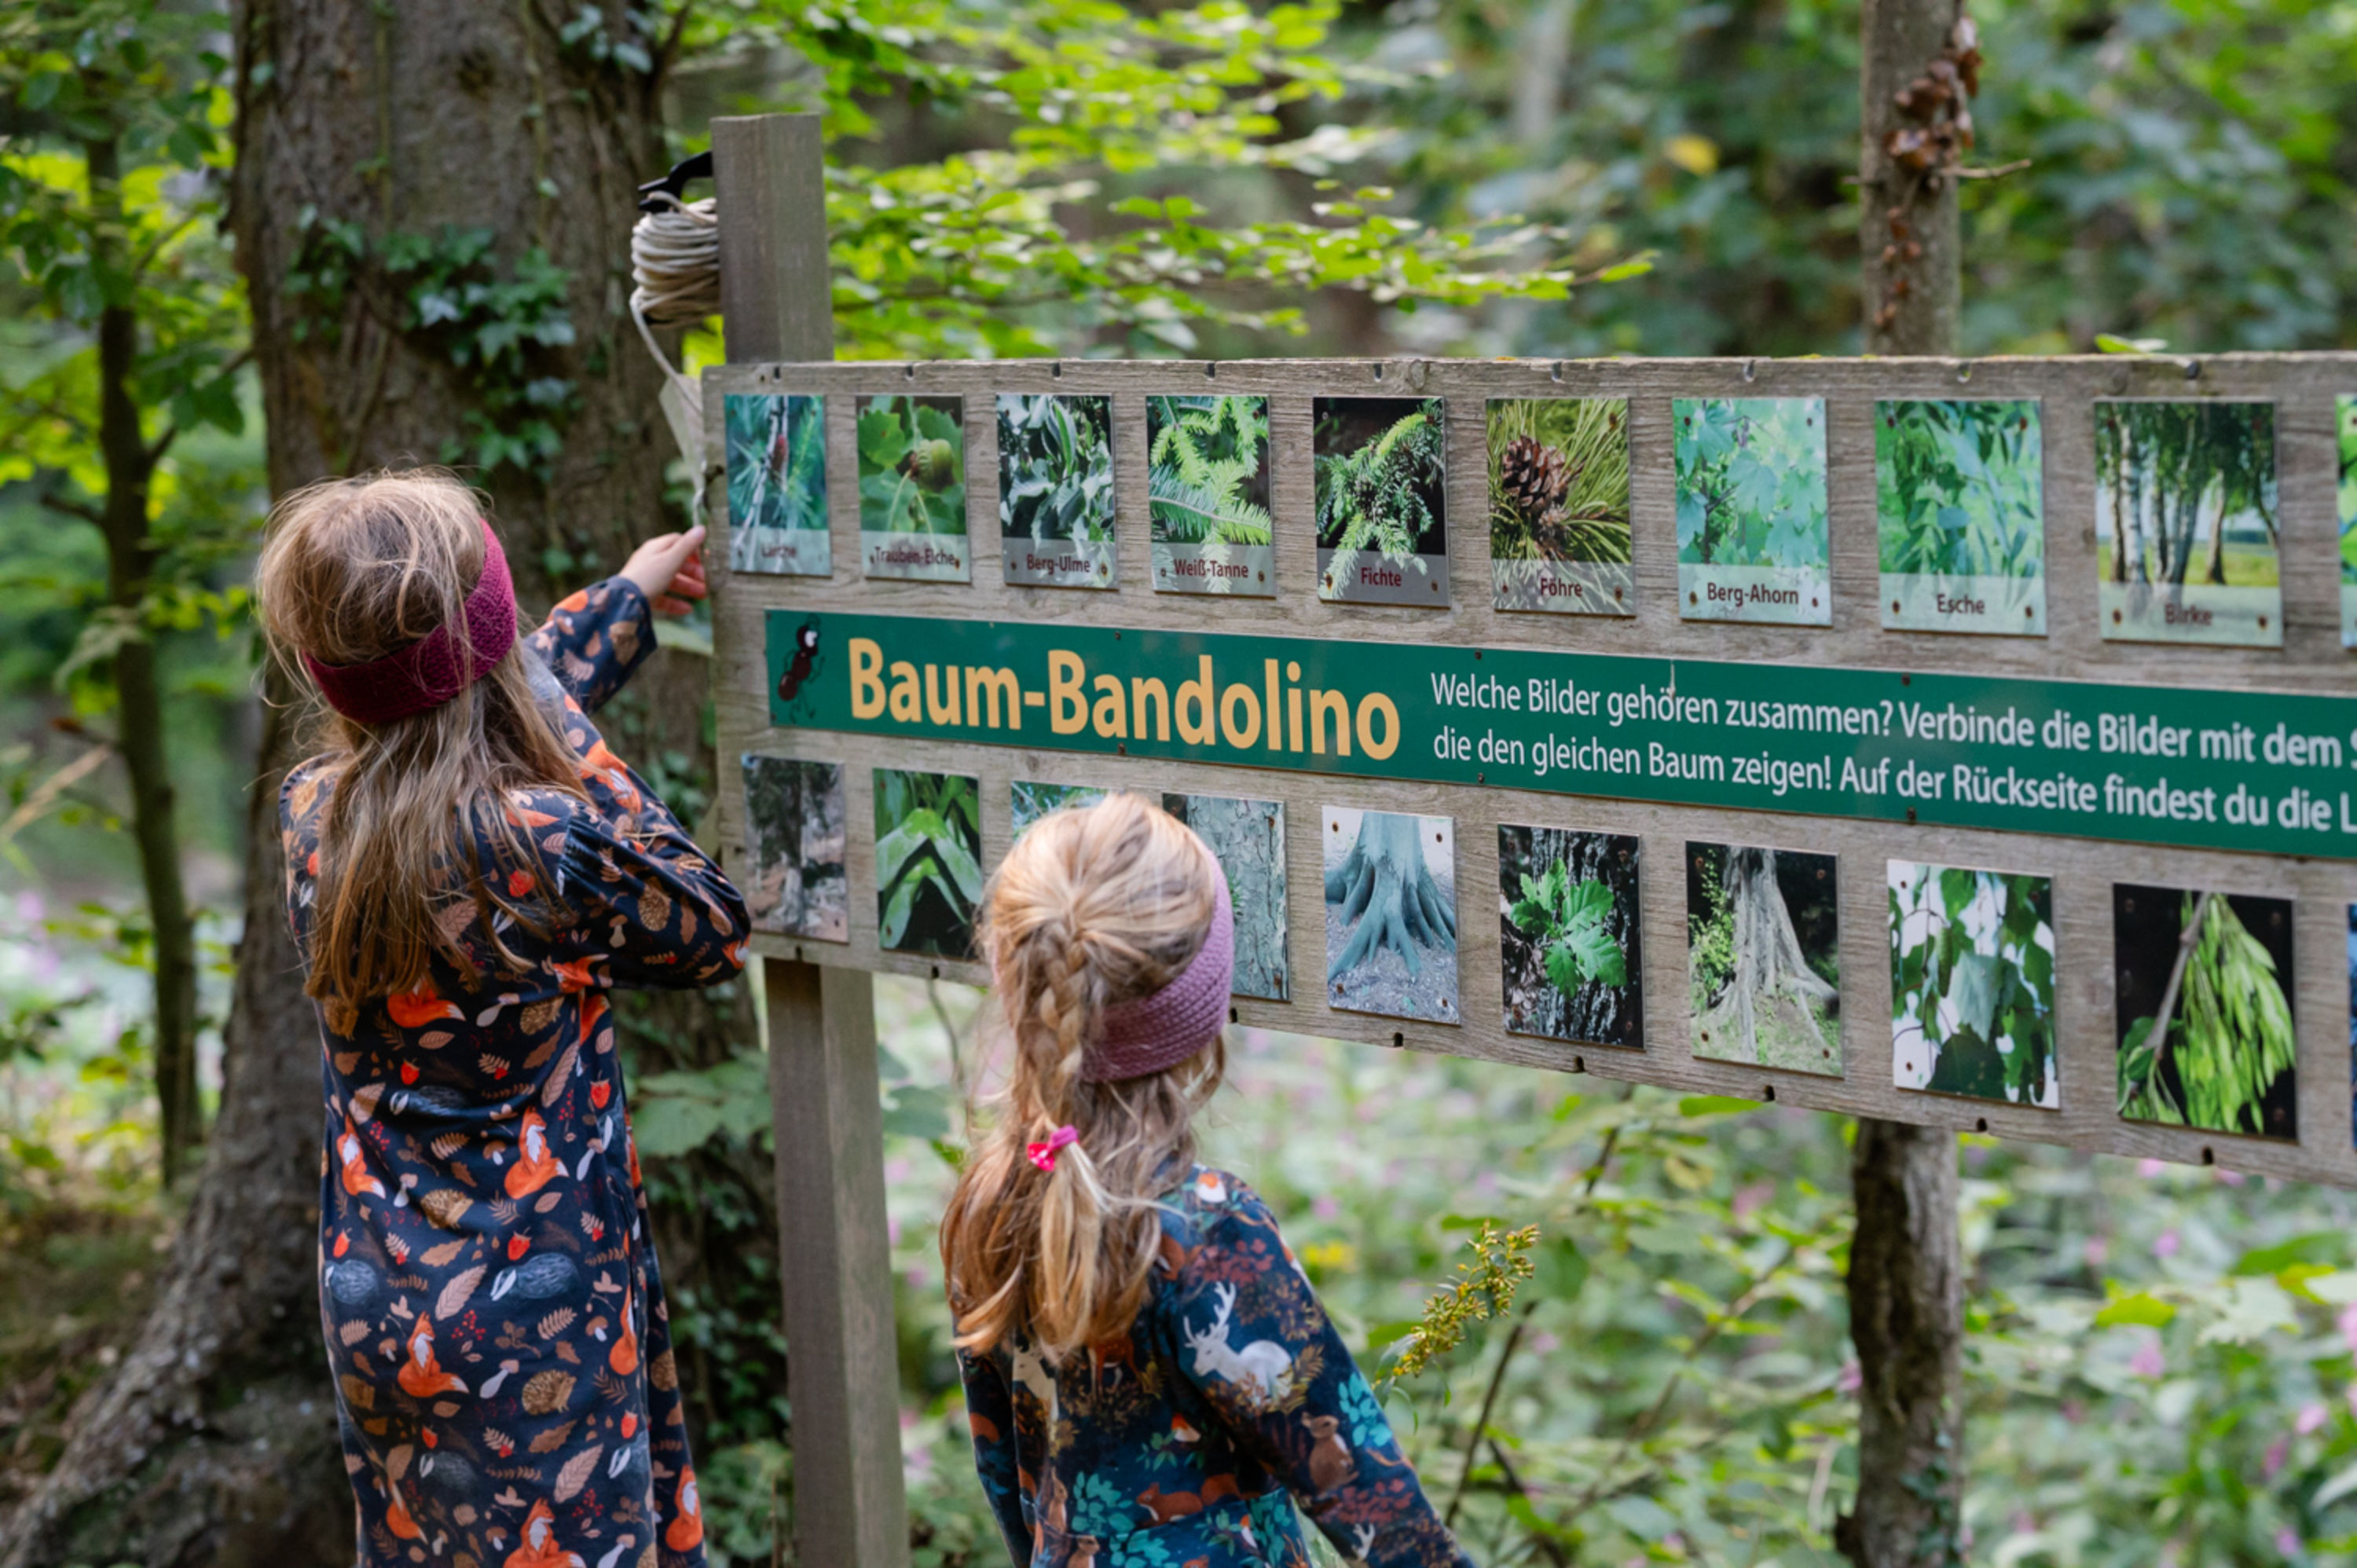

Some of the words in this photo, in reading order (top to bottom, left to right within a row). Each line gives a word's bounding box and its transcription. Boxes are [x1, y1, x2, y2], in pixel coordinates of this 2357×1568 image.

[874, 546, 955, 565] Trauben-Eiche
[1027, 554, 1091, 574] Berg-Ulme
[1174, 559, 1249, 579] Weiß-Tanne
[1361, 567, 1402, 587] Fichte
[1541, 577, 1583, 597] Föhre
[1707, 582, 1799, 607] Berg-Ahorn
[1937, 594, 1985, 614] Esche
[2165, 603, 2213, 626] Birke
[849, 638, 1402, 760] Baum-Bandolino
[1431, 672, 1521, 710] Welche
[1528, 678, 1600, 716] Bilder
[1607, 683, 1718, 727] gehören
[1726, 699, 1893, 737] zusammen?
[1899, 702, 2035, 746] Verbinde
[2042, 709, 2091, 750] die
[2099, 713, 2191, 757] Bilder
[2200, 722, 2256, 762] mit
[2264, 722, 2341, 767] dem
[1434, 726, 1472, 760] die
[1479, 729, 1524, 764] den
[1532, 733, 1640, 775] gleichen
[1649, 742, 1724, 781] Baum
[1732, 751, 1831, 796] zeigen!
[1840, 757, 1890, 794] Auf
[1897, 760, 1945, 798] der
[1953, 764, 2097, 811] Rückseite
[2104, 773, 2216, 822] findest
[2224, 784, 2269, 826] du
[2277, 786, 2332, 831] die
